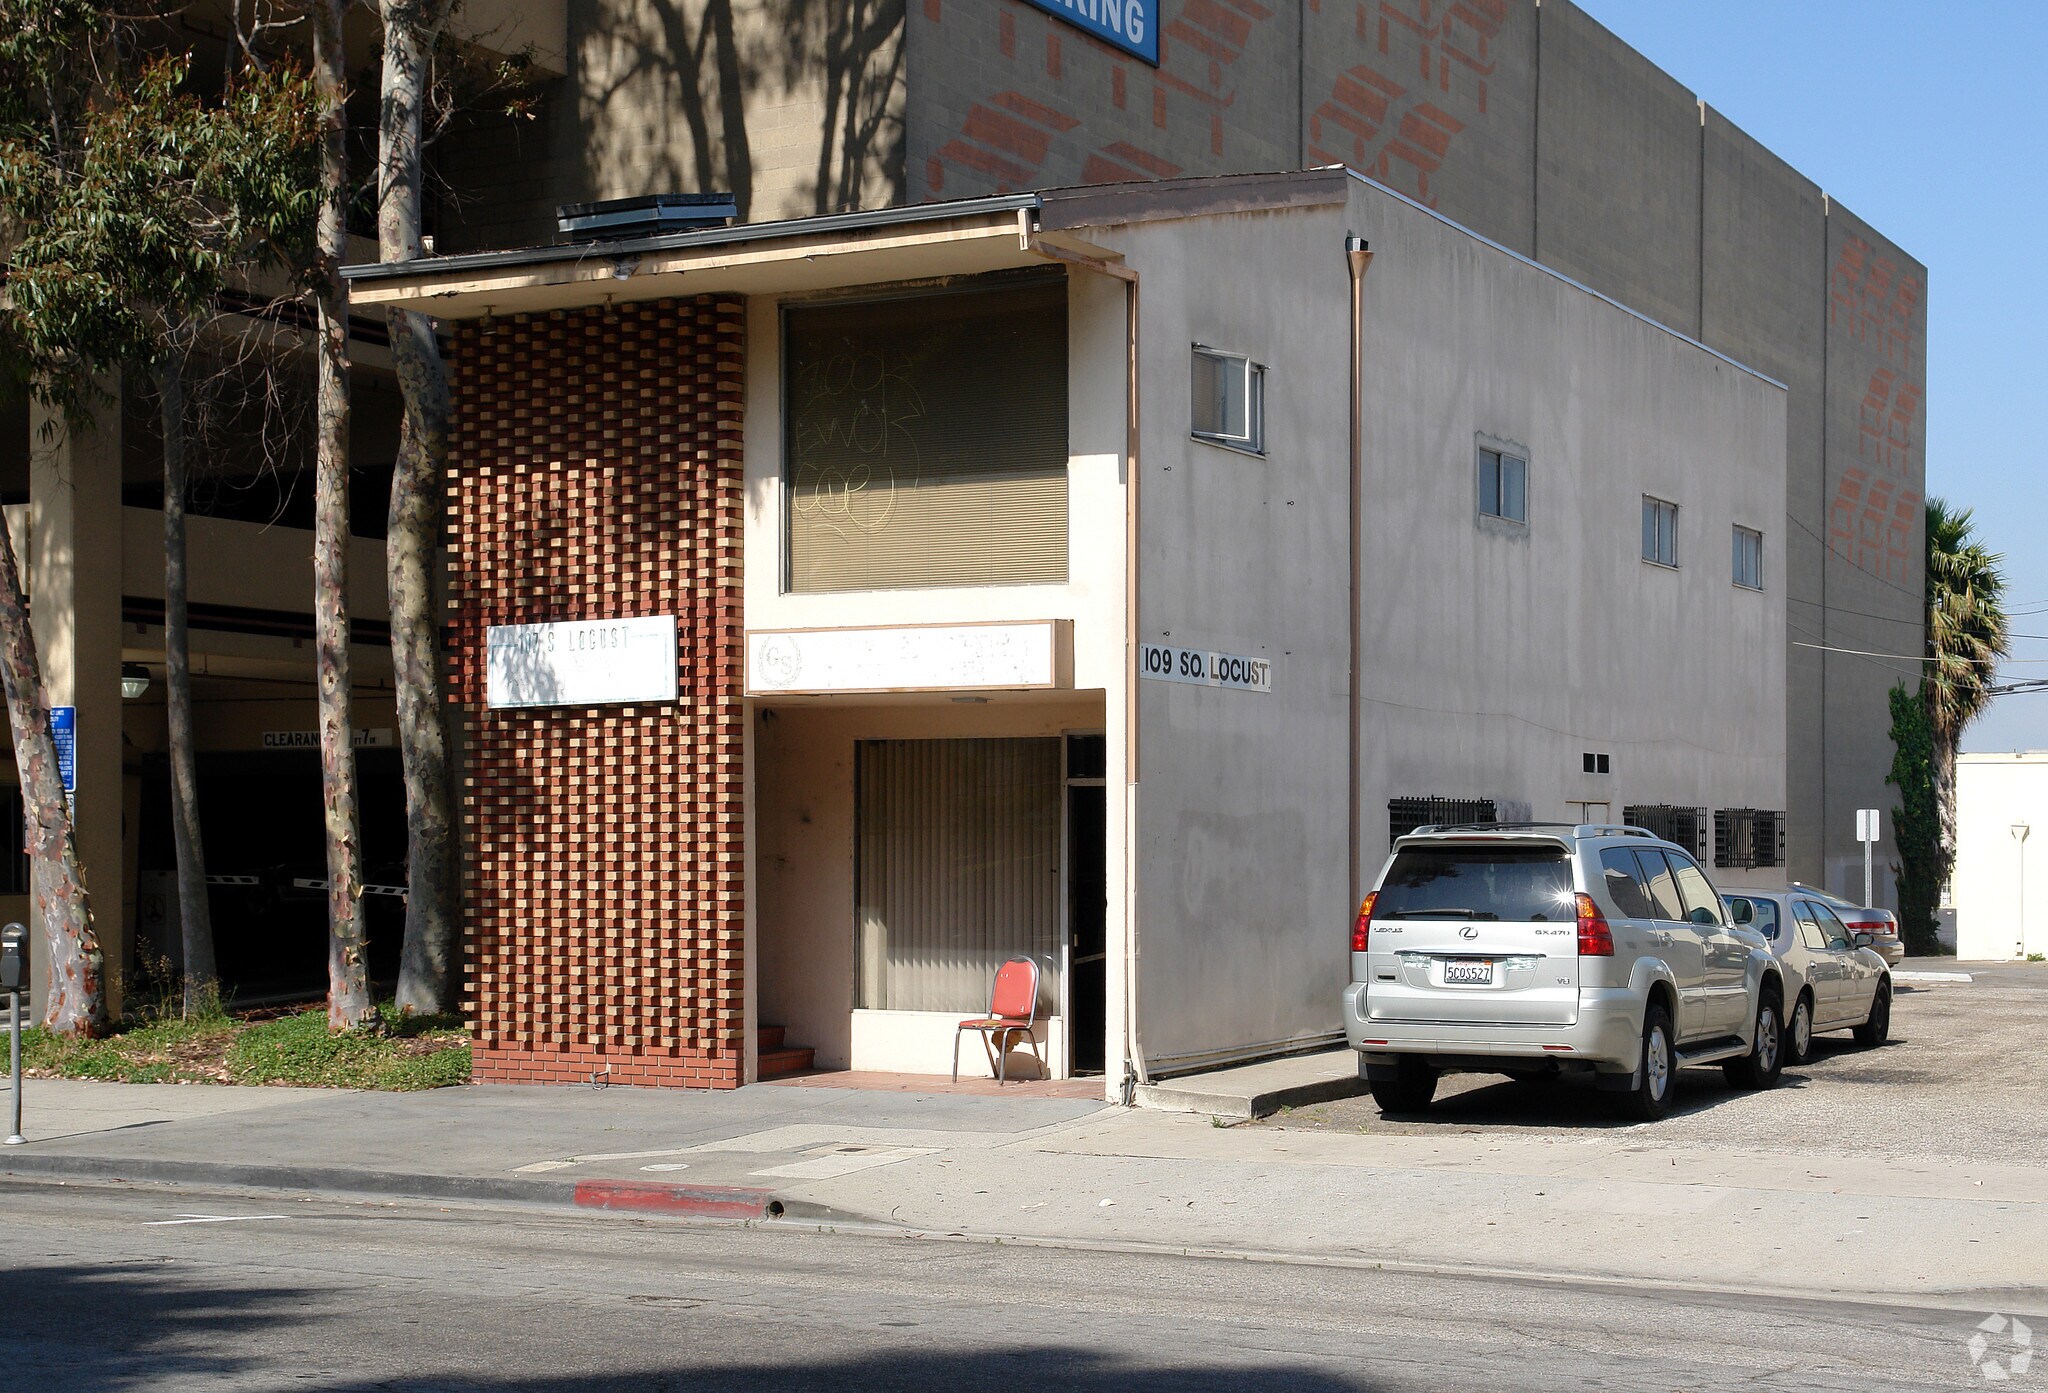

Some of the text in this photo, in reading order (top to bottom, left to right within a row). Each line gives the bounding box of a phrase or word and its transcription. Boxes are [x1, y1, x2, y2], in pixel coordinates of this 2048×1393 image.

[518, 626, 629, 655] 107 S LOCUST
[1145, 647, 1269, 686] 109 SO. LOCUST
[264, 732, 321, 746] CLEARAN
[361, 729, 370, 745] 7
